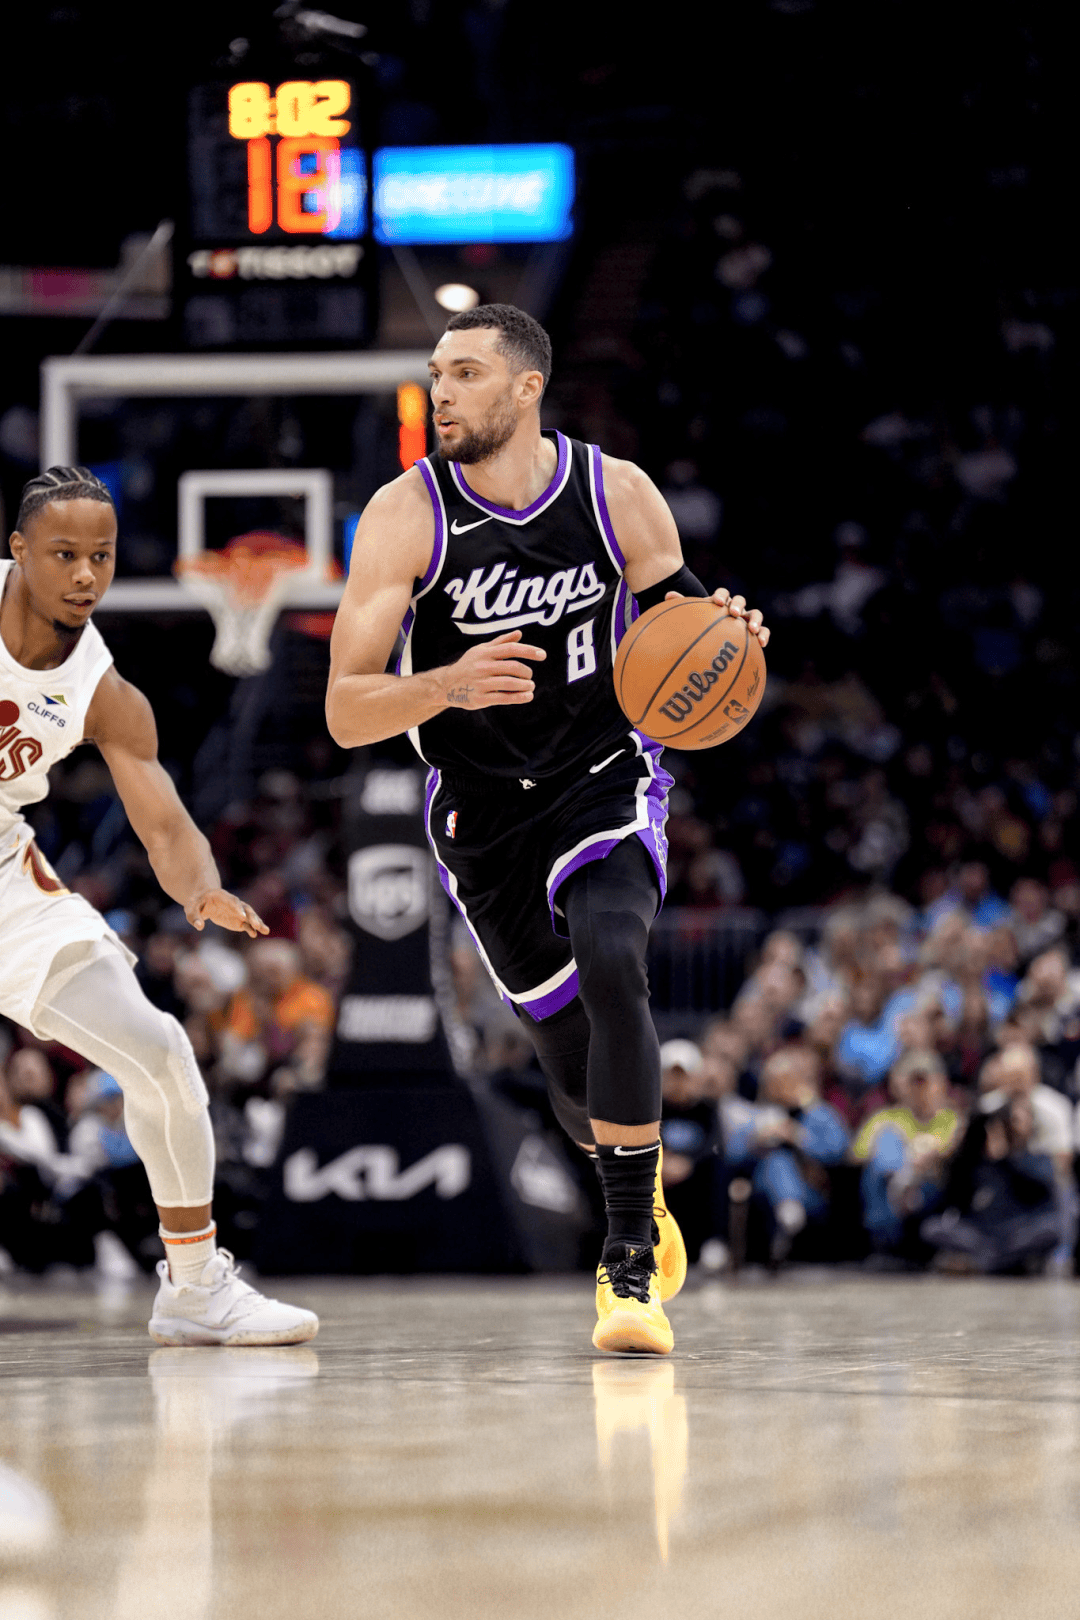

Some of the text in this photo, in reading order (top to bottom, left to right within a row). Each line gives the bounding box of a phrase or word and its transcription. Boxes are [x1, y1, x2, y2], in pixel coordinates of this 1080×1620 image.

[229, 80, 351, 138] 8:02
[247, 137, 342, 233] 18
[444, 561, 606, 635] Kings
[566, 617, 597, 685] 8
[658, 640, 739, 723] Wilson
[27, 703, 66, 728] CLIFFS
